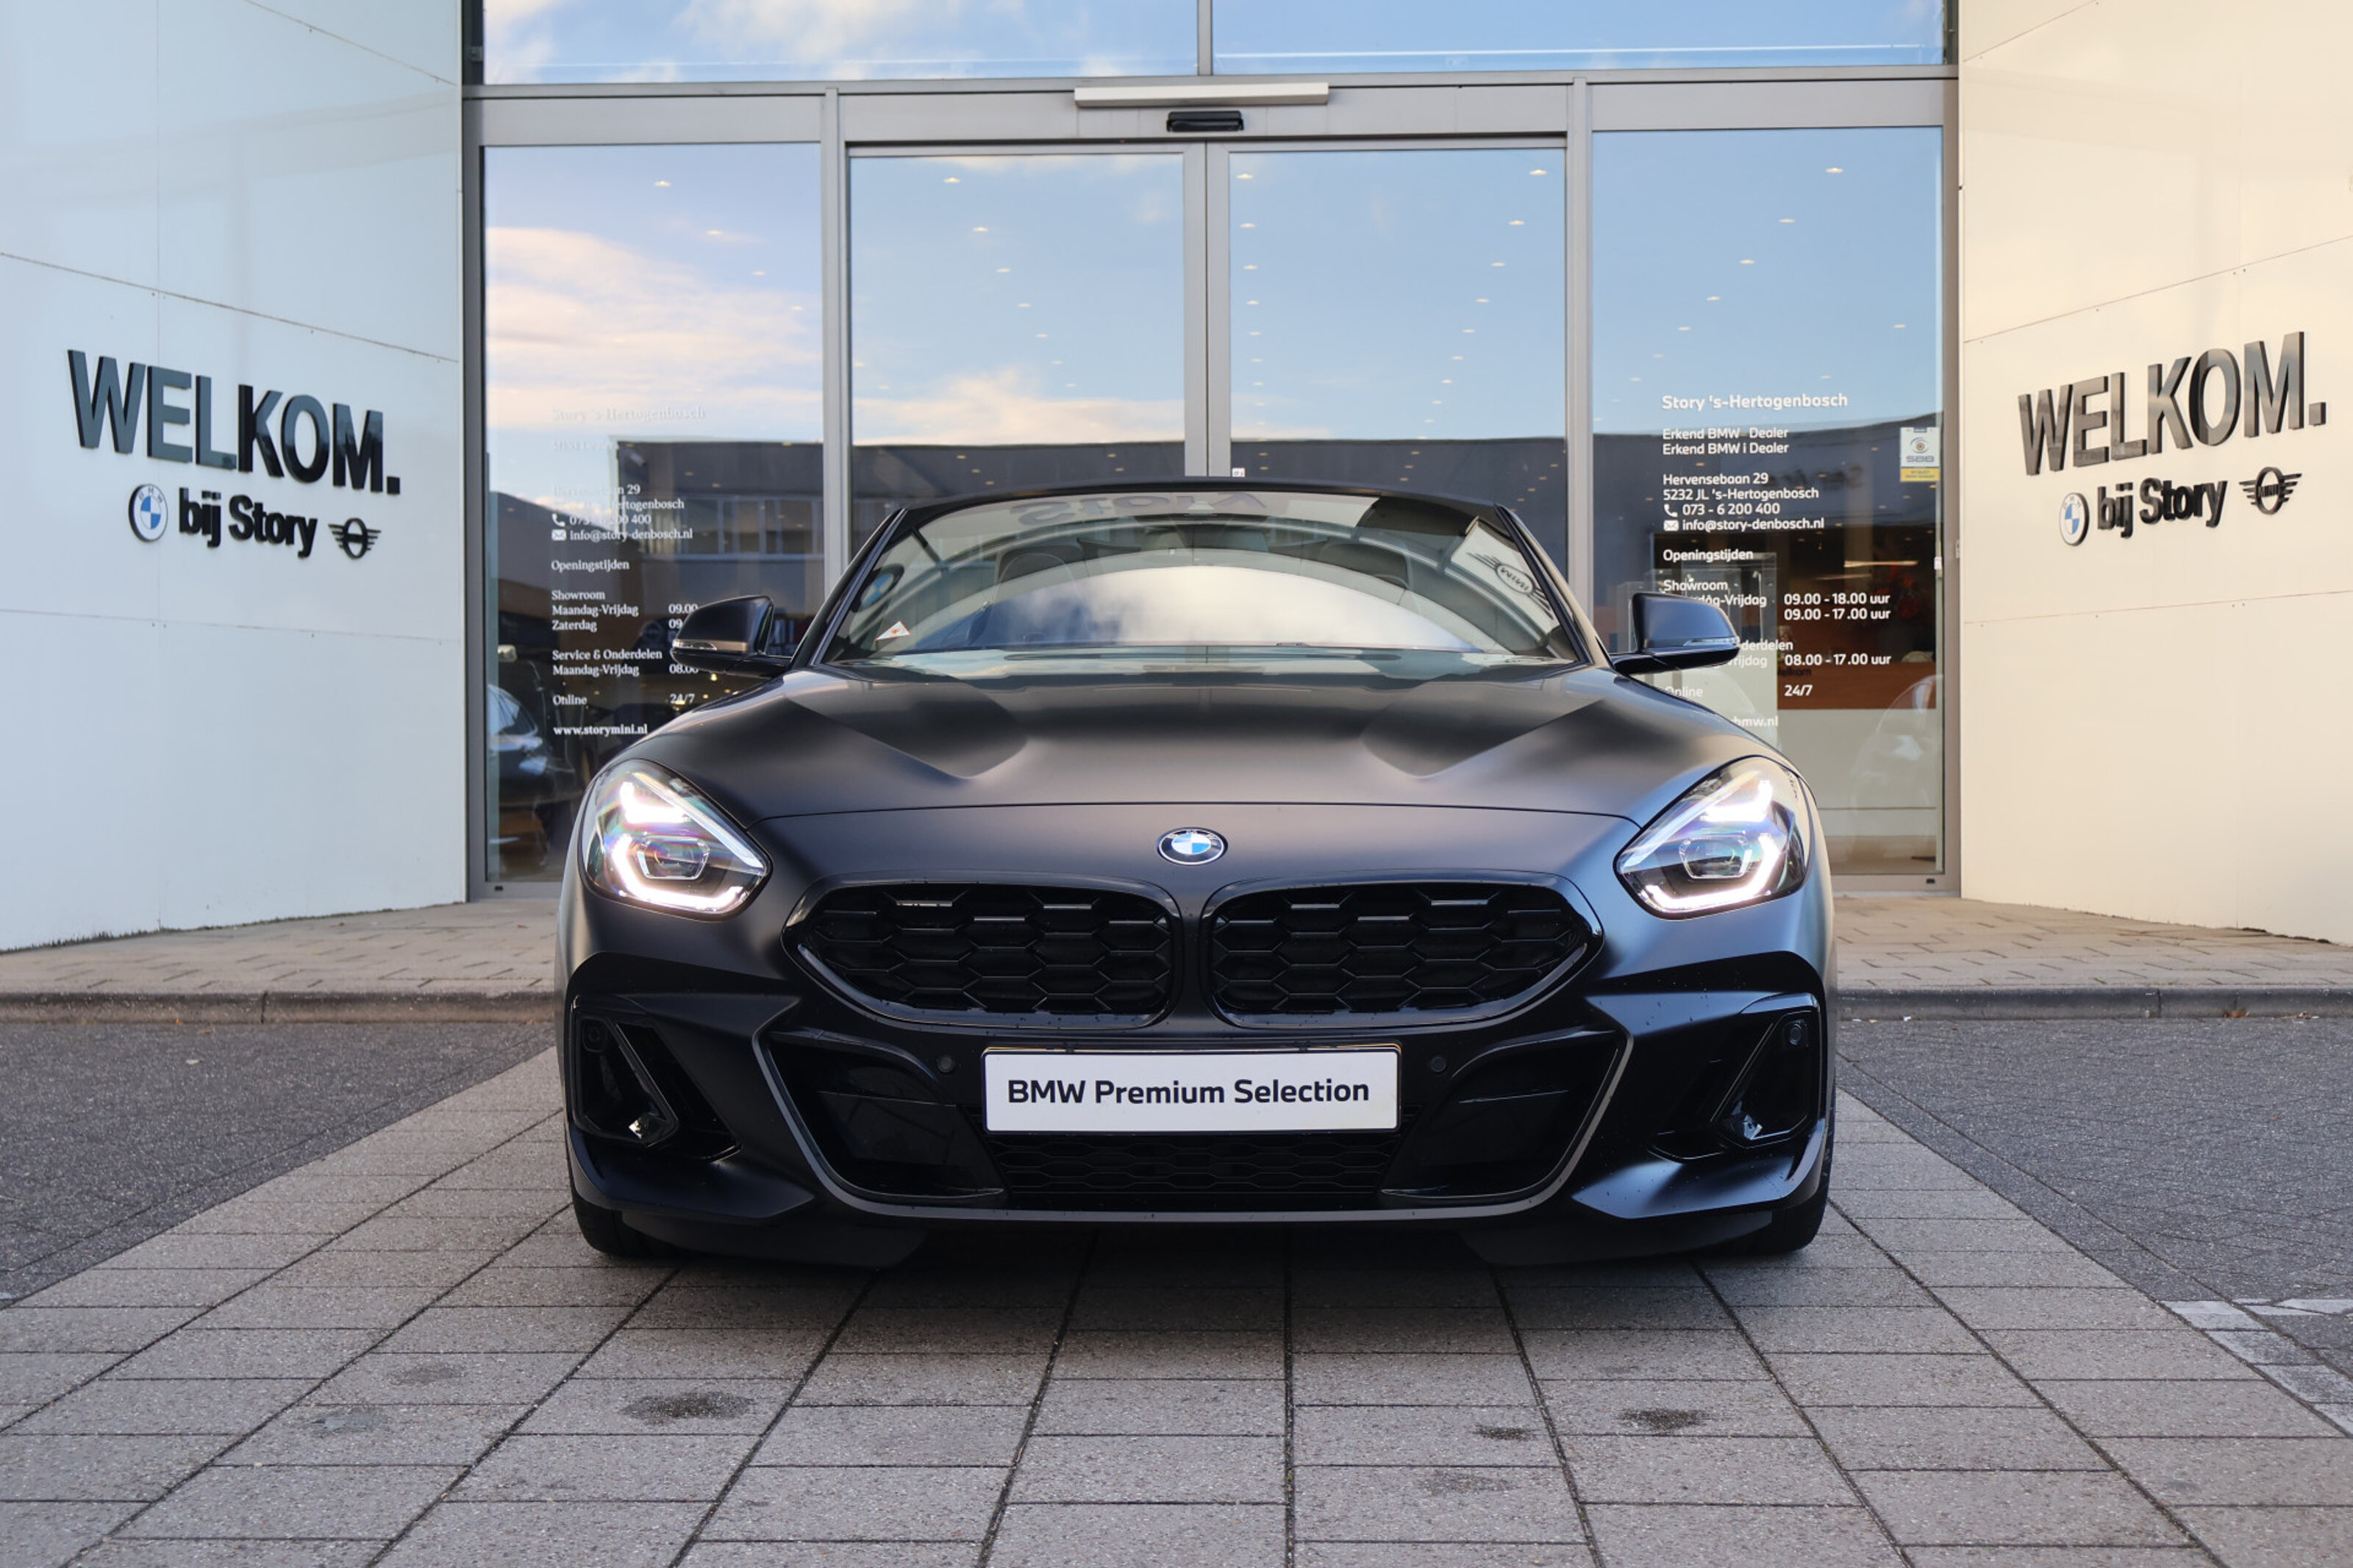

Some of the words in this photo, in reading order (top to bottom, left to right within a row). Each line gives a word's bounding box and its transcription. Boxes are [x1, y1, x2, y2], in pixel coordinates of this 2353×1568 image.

[1662, 395, 1706, 411] Story
[1709, 394, 1848, 411] 's-Hertogenbosch
[2017, 331, 2327, 476] WELKOM.
[68, 349, 401, 495] WELKOM.
[1663, 428, 1705, 440] Erkend
[1707, 428, 1739, 440] BMW
[1749, 427, 1788, 439] Dealer
[1663, 443, 1705, 455] Erkend
[1707, 443, 1740, 454] BMW
[1743, 443, 1746, 454] i
[1750, 443, 1788, 454] Dealer
[1663, 473, 1751, 486] Hervensebaan
[1753, 473, 1769, 484] 29
[627, 484, 640, 495] 29
[1663, 489, 1693, 501] 5232
[1695, 489, 1709, 501] JL
[1711, 487, 1819, 503] 's-Hertogenbosch
[1682, 504, 1705, 515] 073
[1717, 503, 1725, 515] 6
[1728, 503, 1753, 515] 200
[1755, 502, 1780, 515] 400
[2097, 482, 2133, 539] bij
[2139, 478, 2228, 528] Story
[179, 487, 221, 548] bij
[229, 495, 317, 559] Story
[631, 515, 651, 525] 400
[1682, 518, 1824, 531] info@story-denbosch.nl
[570, 529, 693, 543] info@story-denbosch.nl
[1663, 549, 1754, 562] Openingstijden
[551, 559, 629, 572] Openingstijden
[1663, 579, 1728, 591] Showroom
[551, 590, 605, 601] Showroom
[1784, 593, 1821, 606] 09.00
[1832, 593, 1868, 605] 18.00
[1870, 594, 1890, 604] uur
[551, 604, 639, 617] Maandag-Vrijdag
[1784, 609, 1821, 620] 09.00
[1871, 609, 1891, 619] uur
[551, 619, 597, 632] Zaterdag
[668, 619, 683, 629] 09
[1740, 640, 1793, 651] derdelen
[552, 649, 591, 660] Service
[593, 649, 601, 660] &
[603, 649, 663, 660] Onderdelen
[1785, 654, 1821, 666] 08.00
[1871, 654, 1891, 665] uur
[552, 665, 640, 677] Maandag-Vrijdag
[1785, 685, 1813, 697] 24/7
[552, 695, 588, 706] Online
[670, 694, 696, 704] 24/7
[553, 723, 648, 737] www.storymini.nl
[1007, 1080, 1086, 1103] BMW
[1095, 1080, 1225, 1104] Premium
[1234, 1078, 1369, 1103] Selection
